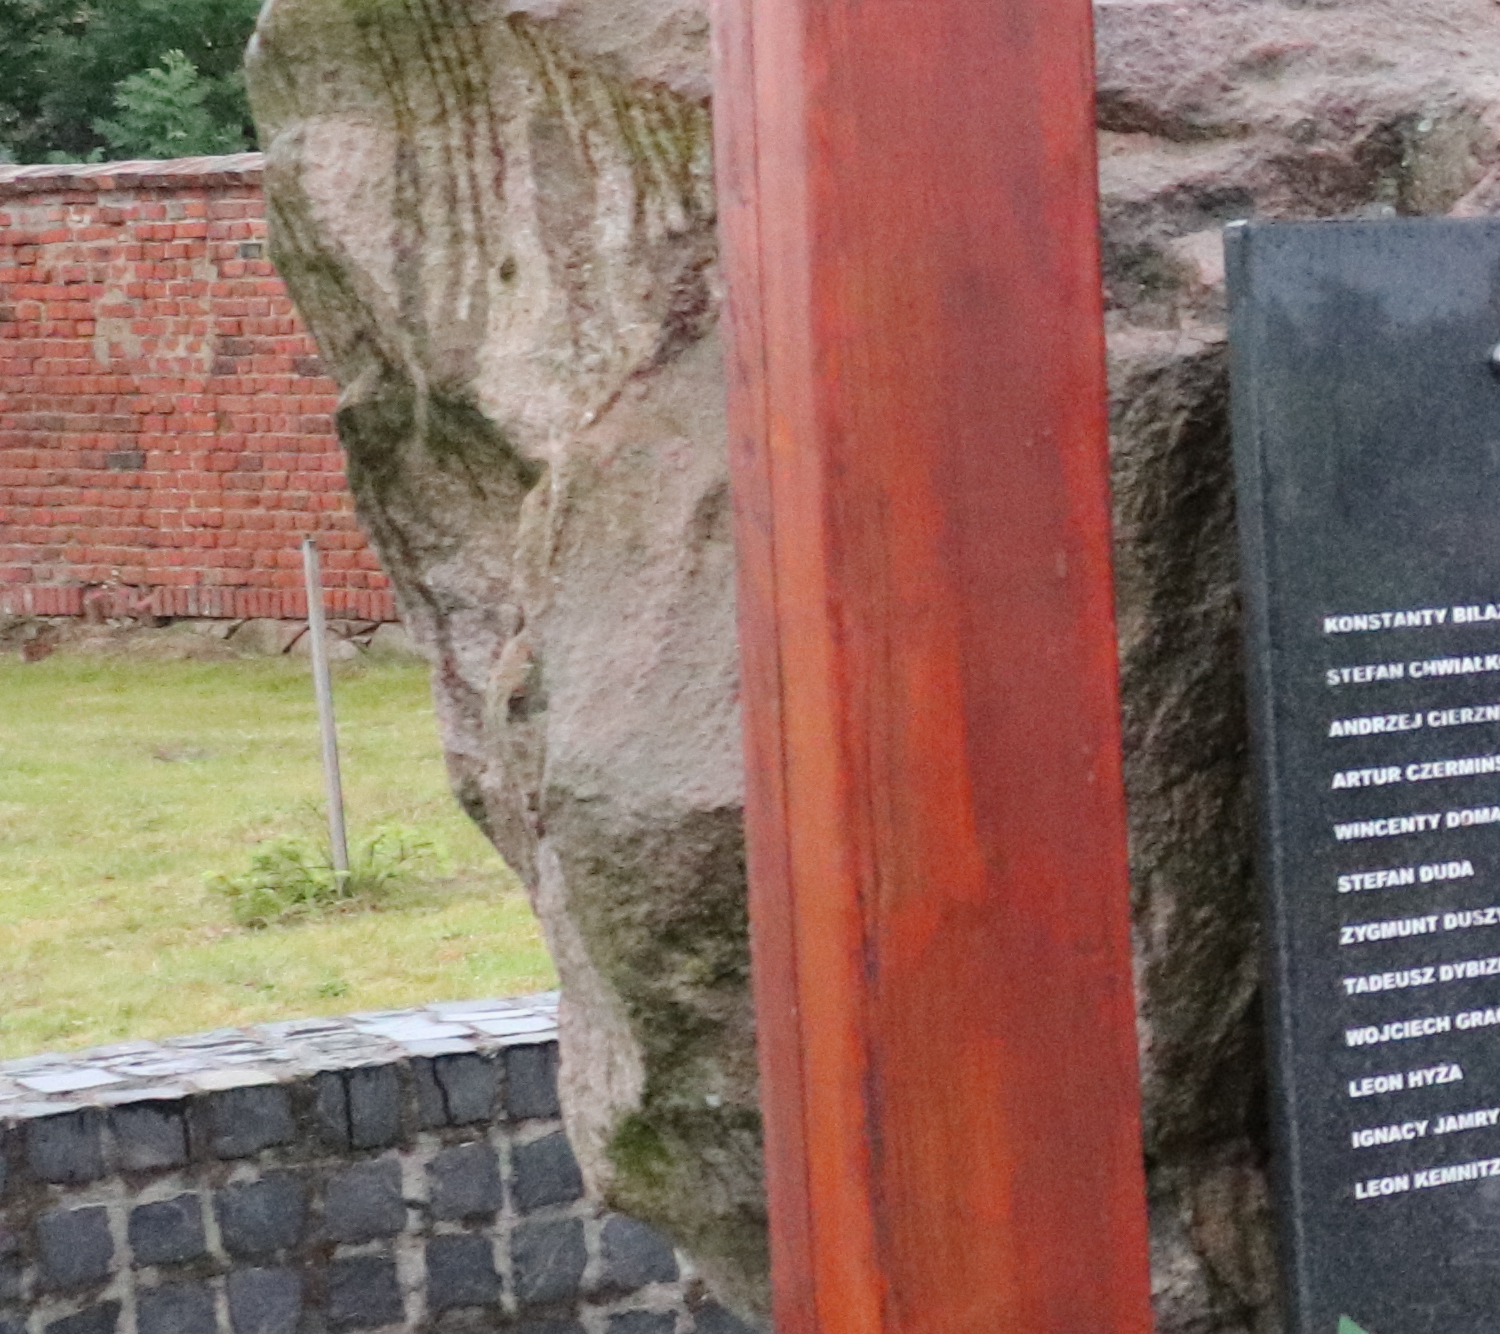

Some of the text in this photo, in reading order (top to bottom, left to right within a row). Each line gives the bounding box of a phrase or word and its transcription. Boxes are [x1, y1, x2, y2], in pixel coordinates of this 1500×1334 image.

[1323, 608, 1446, 633] KONSTANTY
[1326, 662, 1403, 685] STEFAN
[1328, 712, 1422, 737] ANDRZEJ
[1331, 766, 1401, 789] ARTUR
[1333, 813, 1441, 839] WINCENTY
[1337, 867, 1414, 892] STEFAN
[1418, 860, 1474, 882] DUDA
[1339, 915, 1438, 944] ZYGMUNT
[1342, 966, 1435, 994] TADEUSZ
[1345, 1015, 1450, 1046] WOJCIECH
[1348, 1073, 1403, 1097] LEON
[1352, 1119, 1428, 1148] IGNACY
[1433, 1107, 1500, 1134] JAMRY
[1355, 1174, 1409, 1199] LEON
